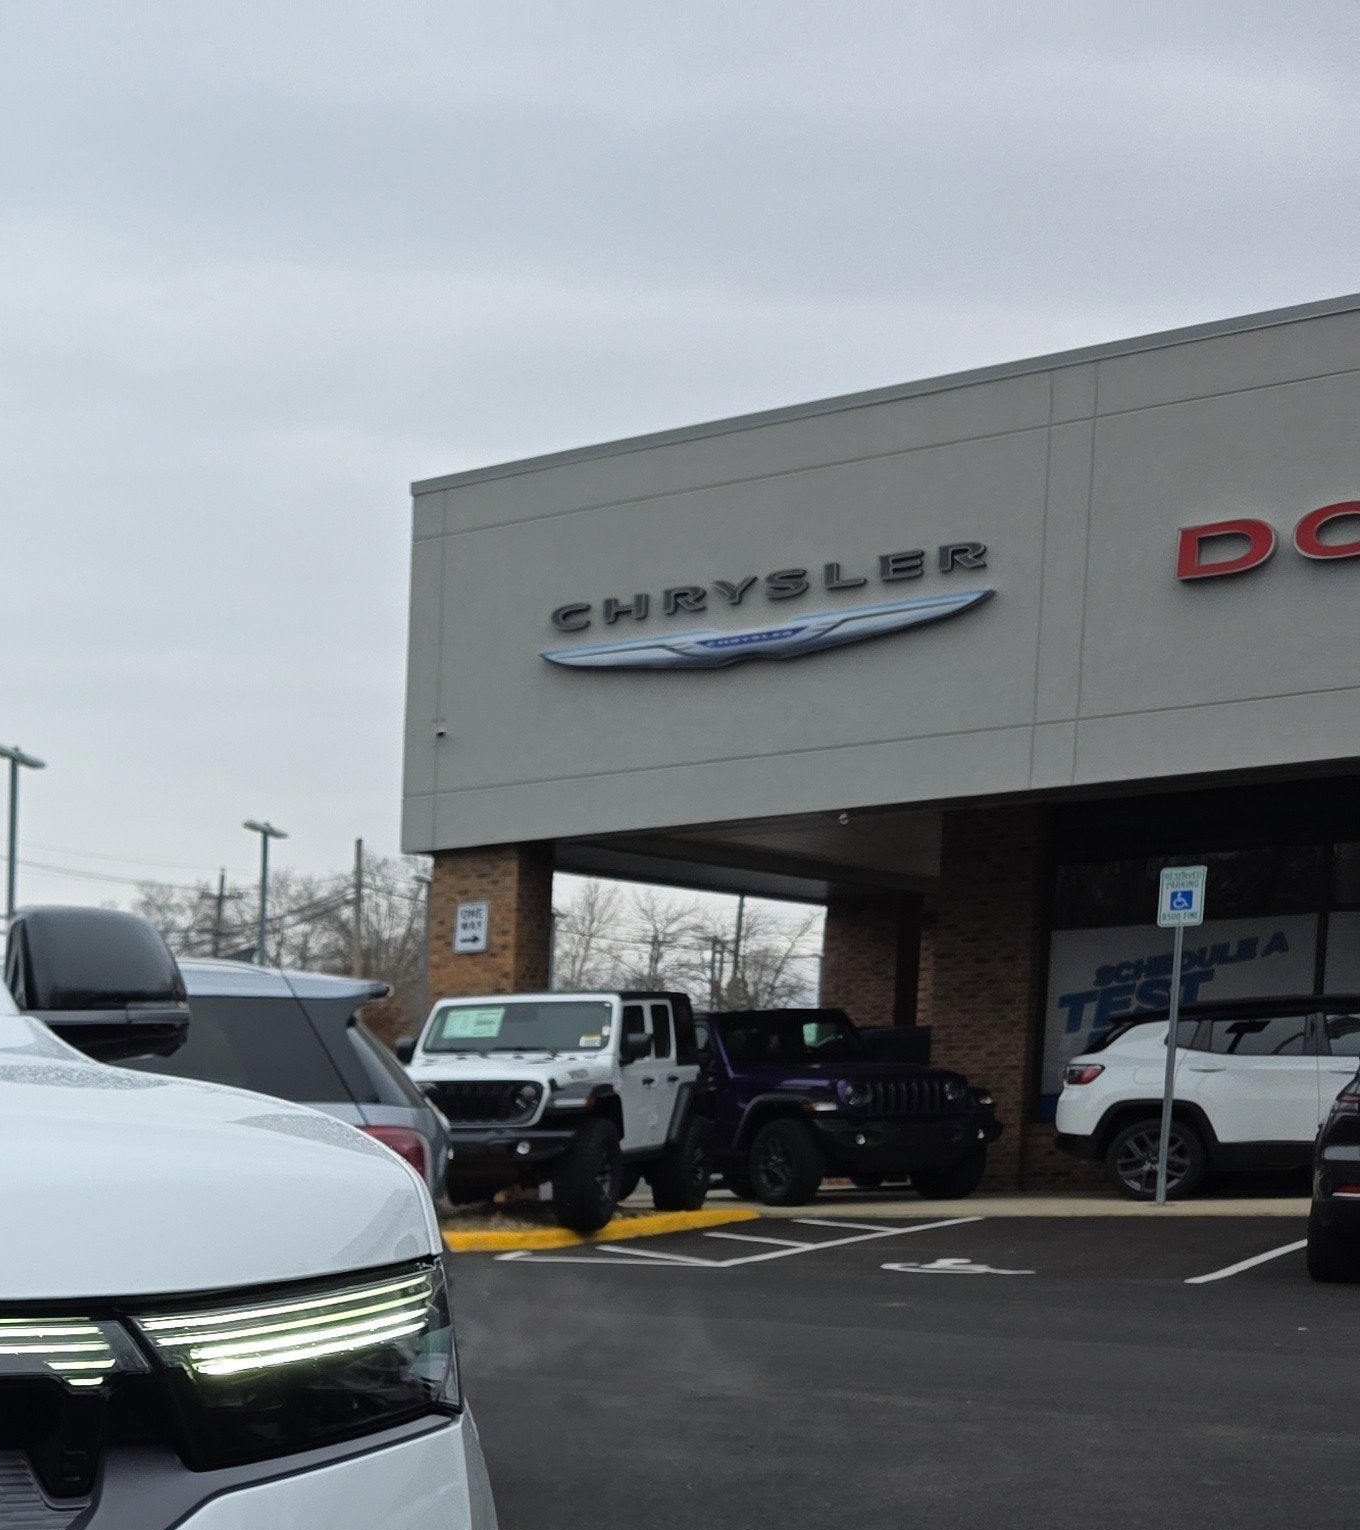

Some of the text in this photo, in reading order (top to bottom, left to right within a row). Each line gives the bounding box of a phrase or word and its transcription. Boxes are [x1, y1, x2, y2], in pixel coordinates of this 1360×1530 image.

[550, 541, 989, 633] CHRYSLER
[1165, 879, 1200, 889] PARKING
[1092, 931, 1290, 987] SCHEDULE A
